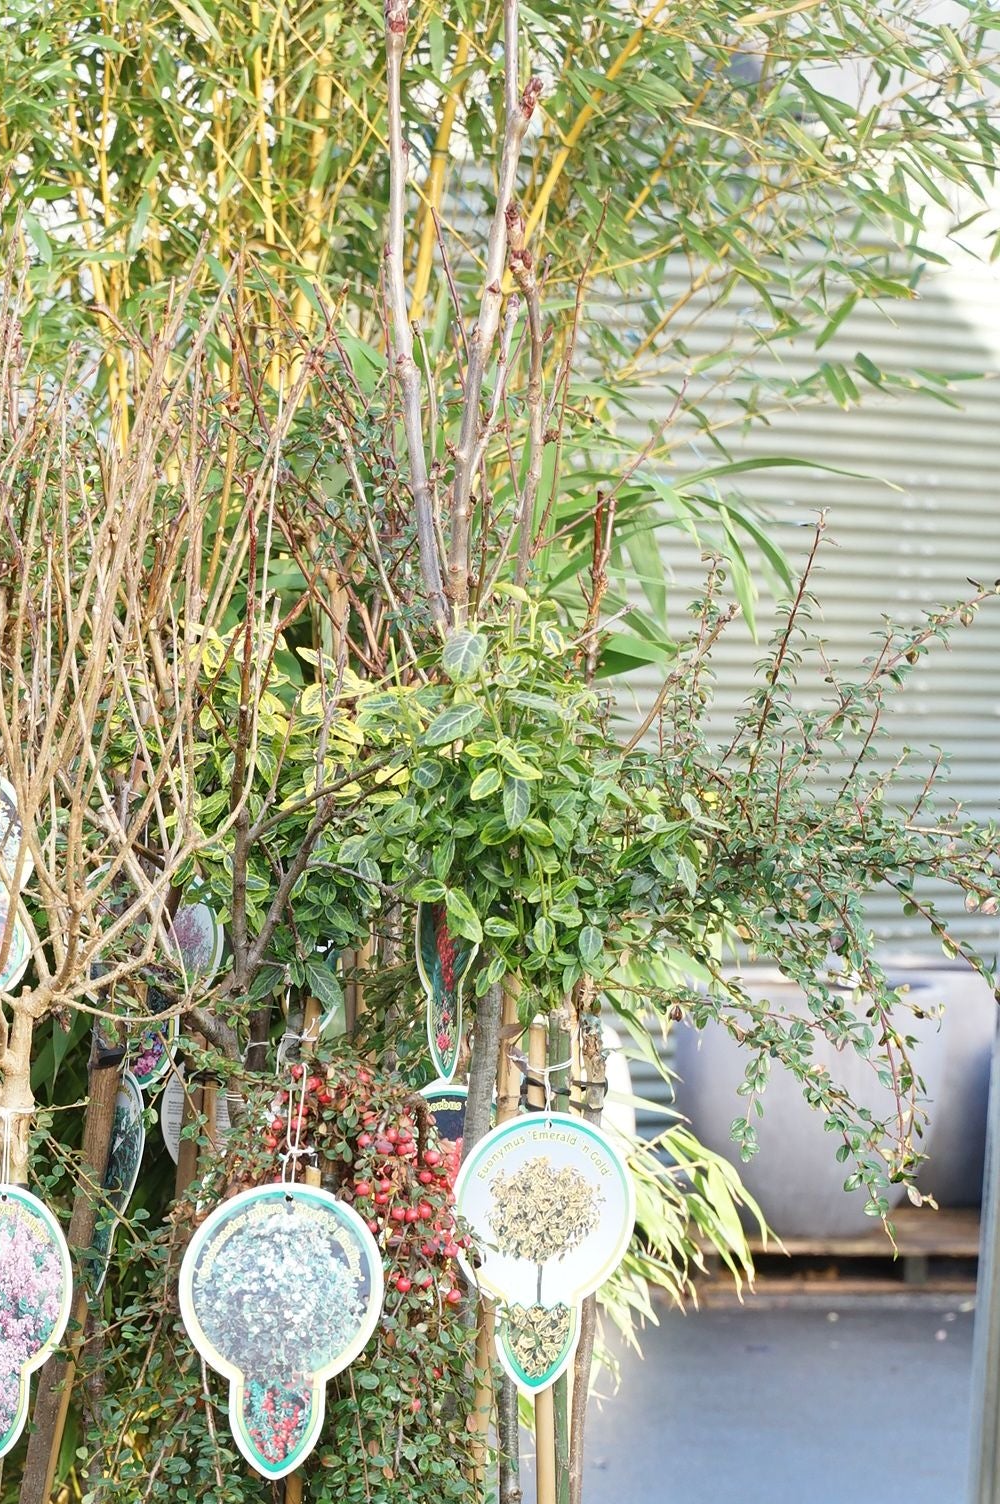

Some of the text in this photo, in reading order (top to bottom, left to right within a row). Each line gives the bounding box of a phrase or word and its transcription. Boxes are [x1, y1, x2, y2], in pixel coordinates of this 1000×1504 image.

[478, 1135, 526, 1179] Euonymus
[527, 1130, 578, 1146] 'Emerald
[590, 1152, 612, 1177] Gold'
[198, 1214, 247, 1277] Cotoneaster
